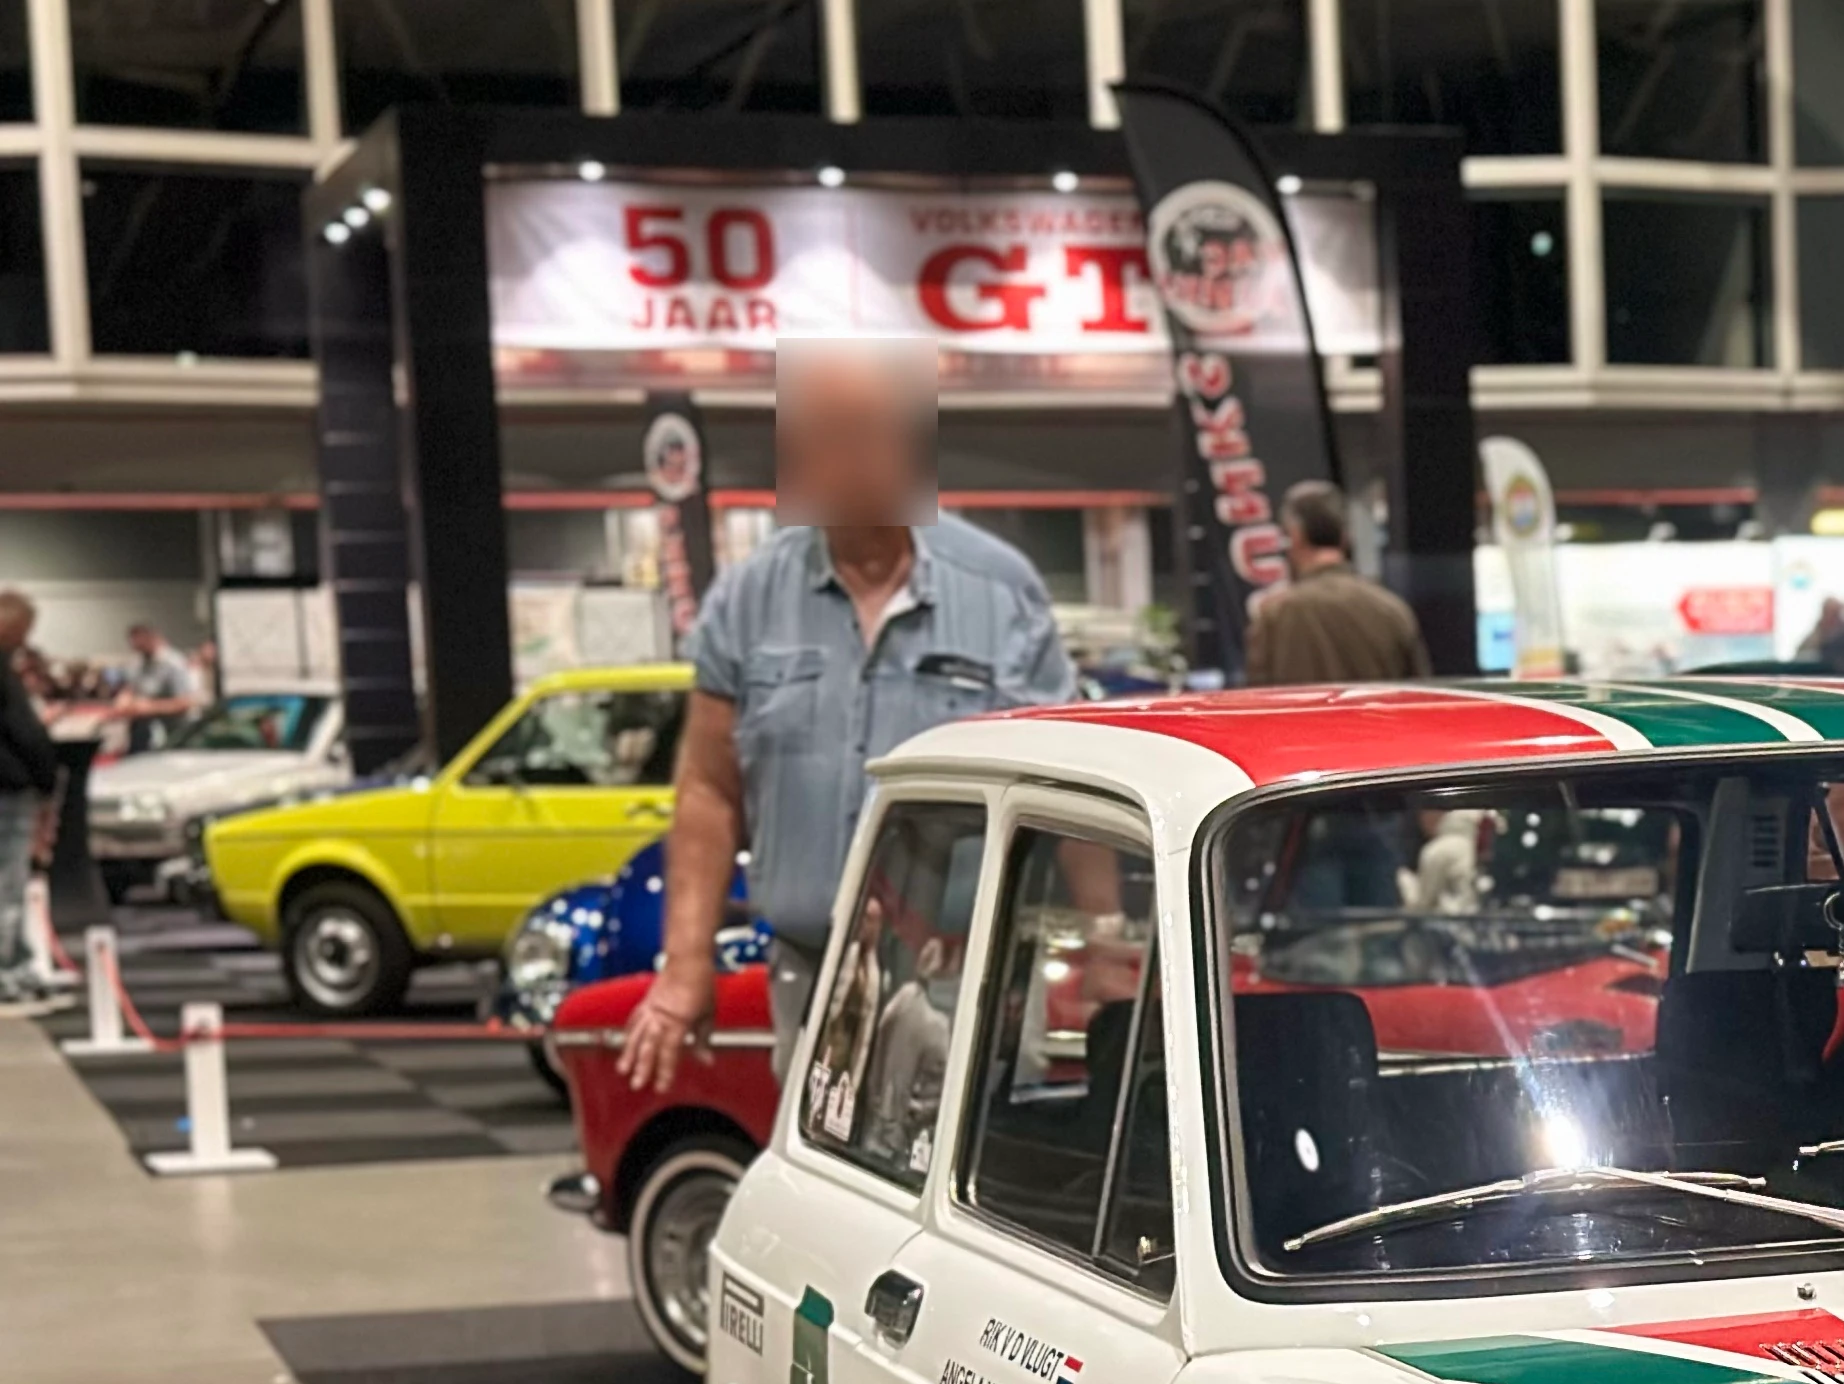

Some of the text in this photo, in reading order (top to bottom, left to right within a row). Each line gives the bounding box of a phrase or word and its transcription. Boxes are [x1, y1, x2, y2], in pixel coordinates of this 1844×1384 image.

[624, 205, 776, 290] 50
[630, 297, 778, 331] JAAR
[720, 1270, 764, 1357] PIRELLI
[979, 1318, 1065, 1381] RIK V D VLUGT
